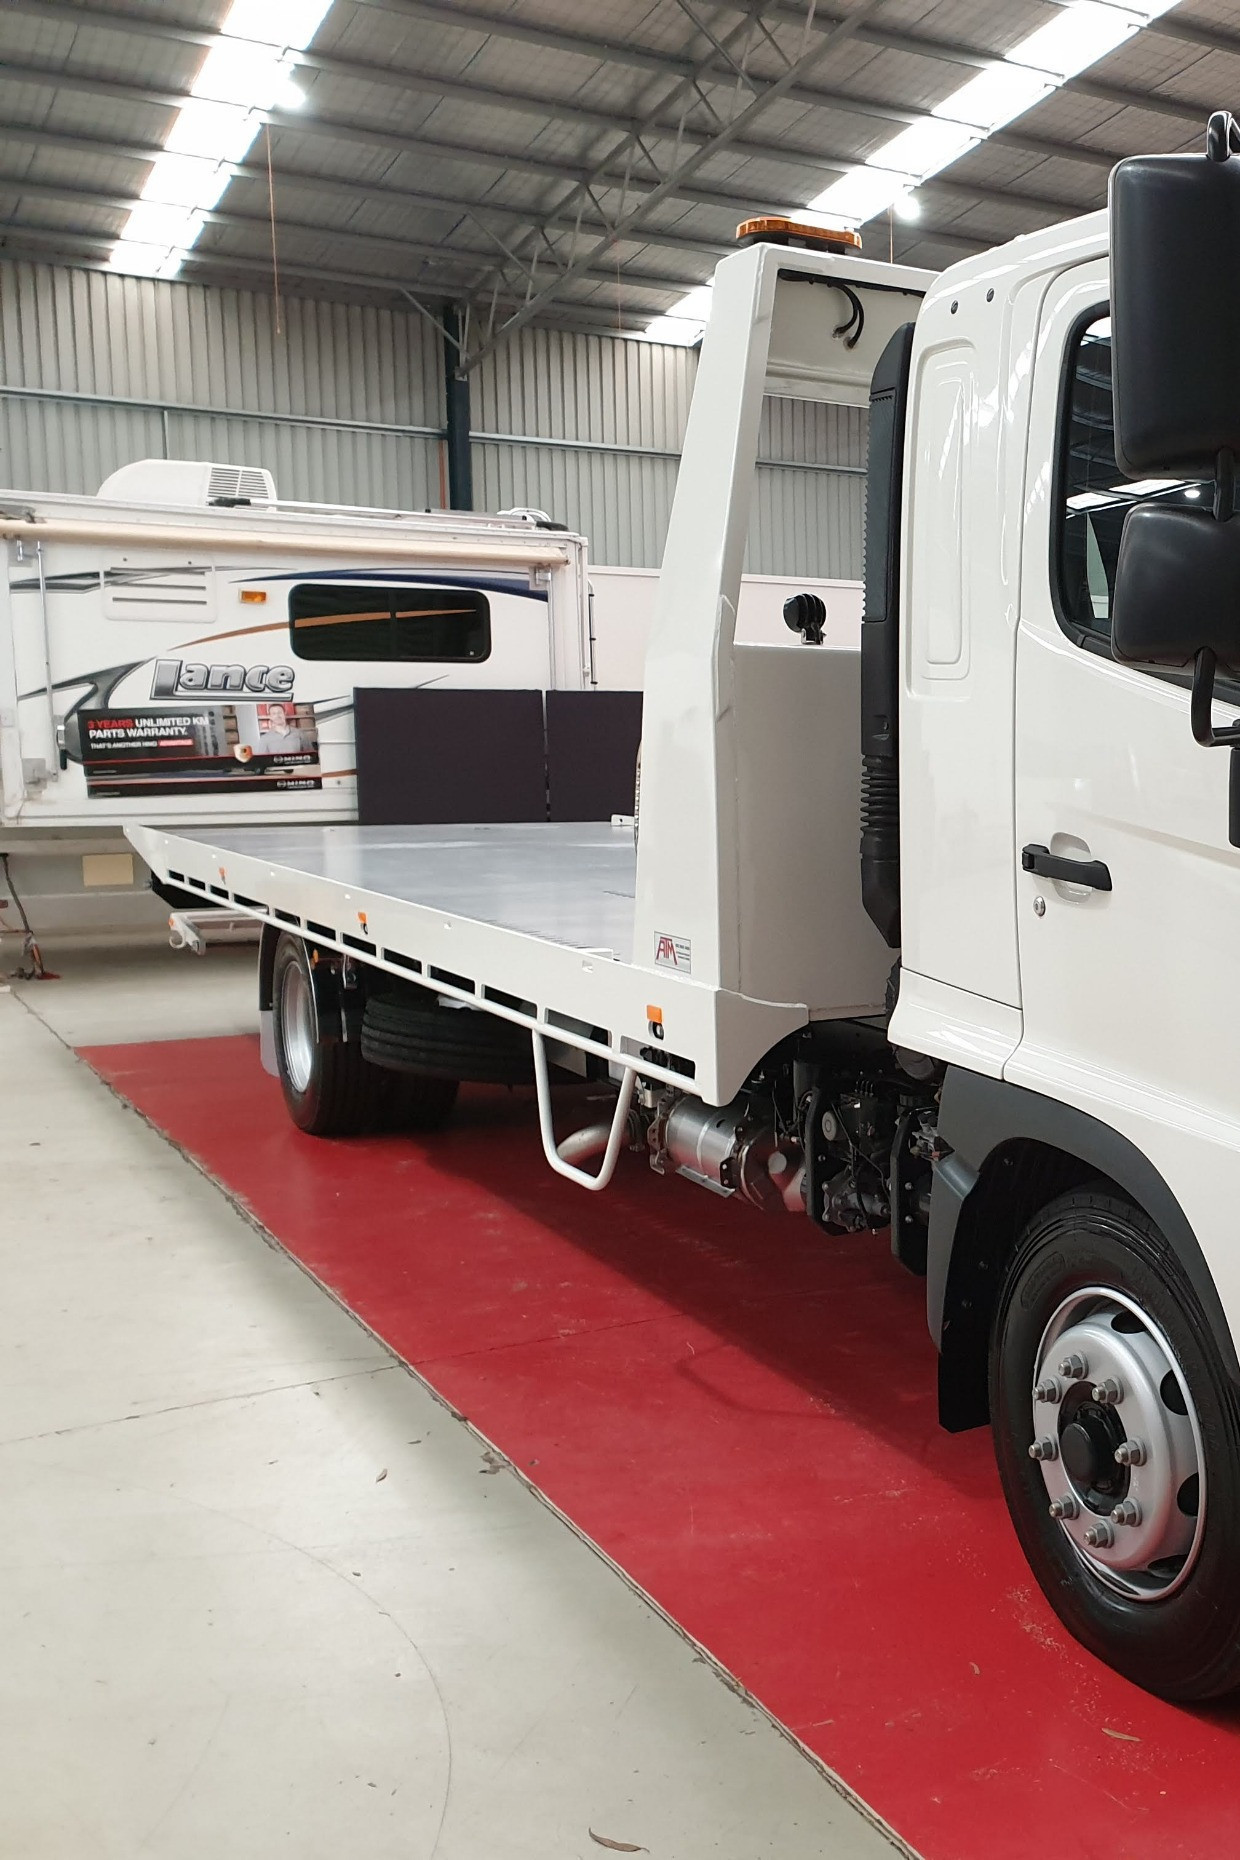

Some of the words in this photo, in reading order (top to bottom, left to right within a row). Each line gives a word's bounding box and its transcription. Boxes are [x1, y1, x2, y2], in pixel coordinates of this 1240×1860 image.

[150, 659, 295, 702] Lance
[97, 719, 134, 729] YEARS
[135, 716, 190, 728] UNLIMITED
[192, 716, 210, 726] KM
[89, 729, 125, 739] PARTS
[126, 727, 188, 738] WARRANTY.
[111, 741, 142, 749] ANOTHER
[656, 936, 678, 965] ATM
